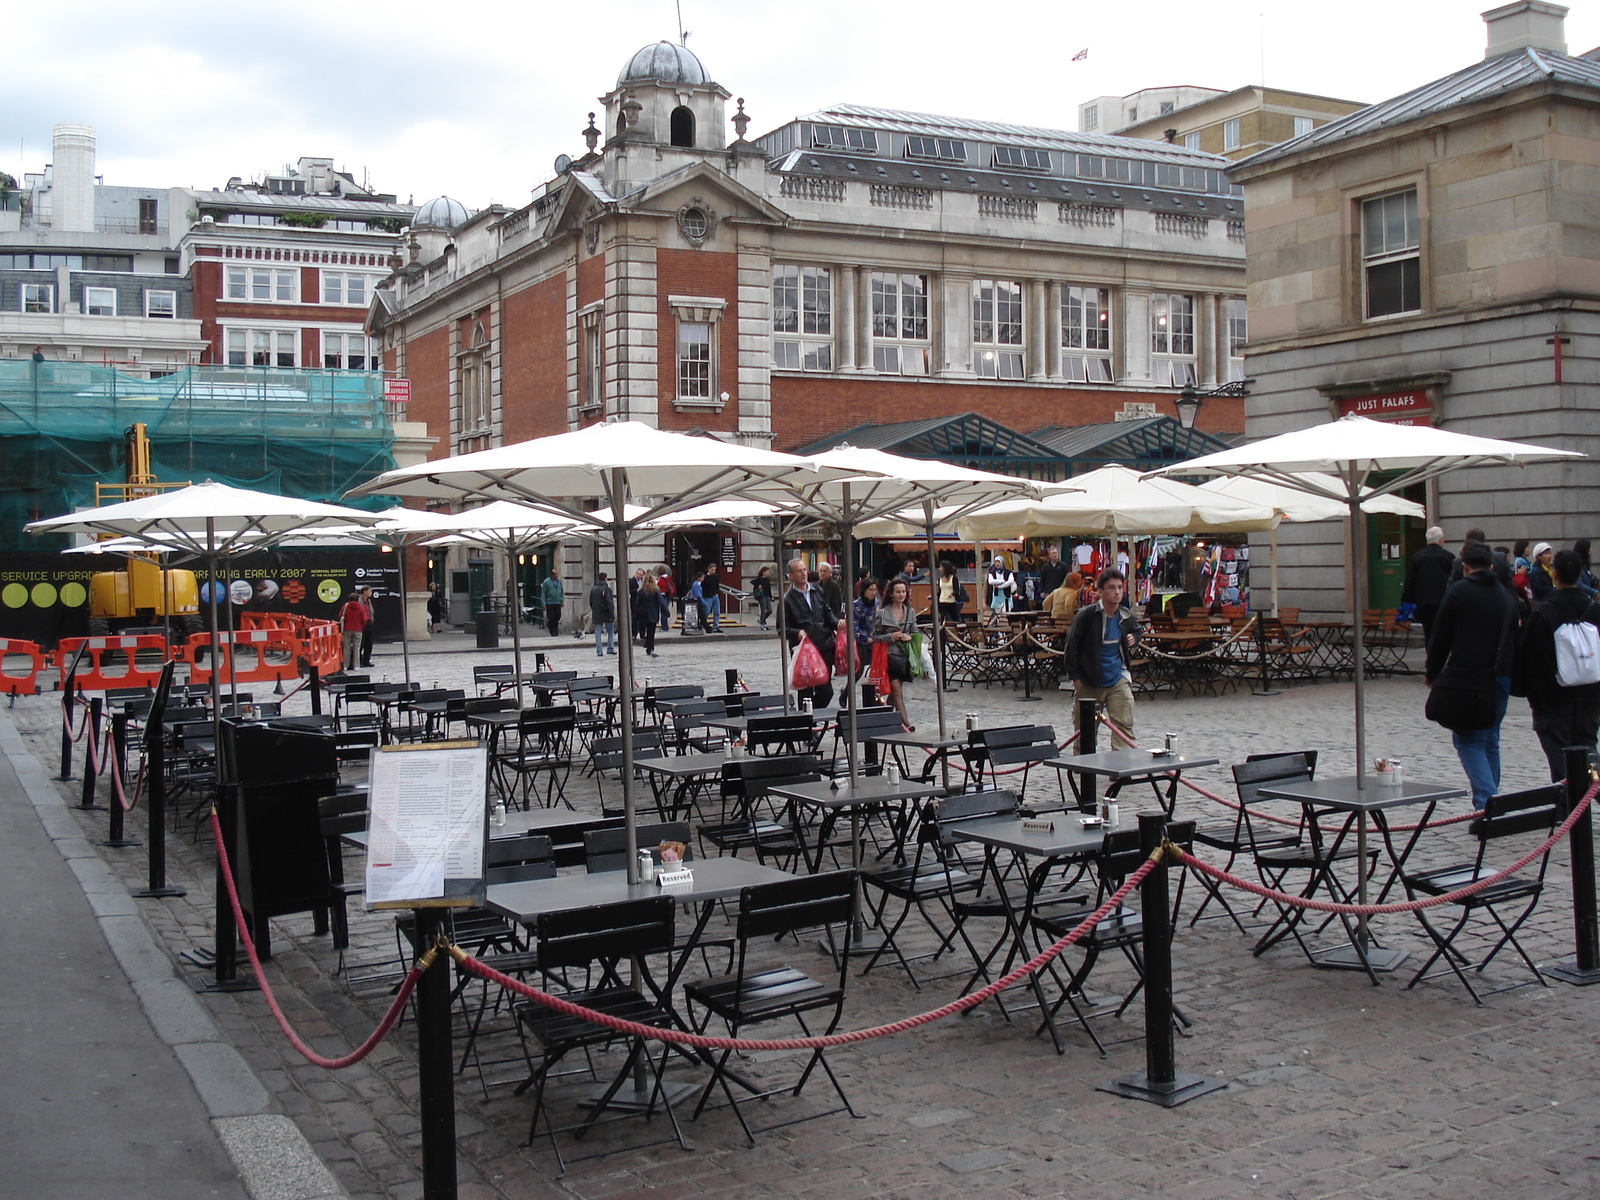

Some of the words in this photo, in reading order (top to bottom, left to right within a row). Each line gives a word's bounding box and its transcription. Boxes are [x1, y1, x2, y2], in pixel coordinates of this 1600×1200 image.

[1357, 400, 1377, 410] JUST
[1382, 396, 1415, 407] FALAFS
[2, 571, 48, 580] SERVICE
[53, 571, 102, 580] UPGRAD
[244, 569, 278, 578] EARLY
[280, 568, 306, 578] 2007
[661, 872, 691, 882] Reserved
